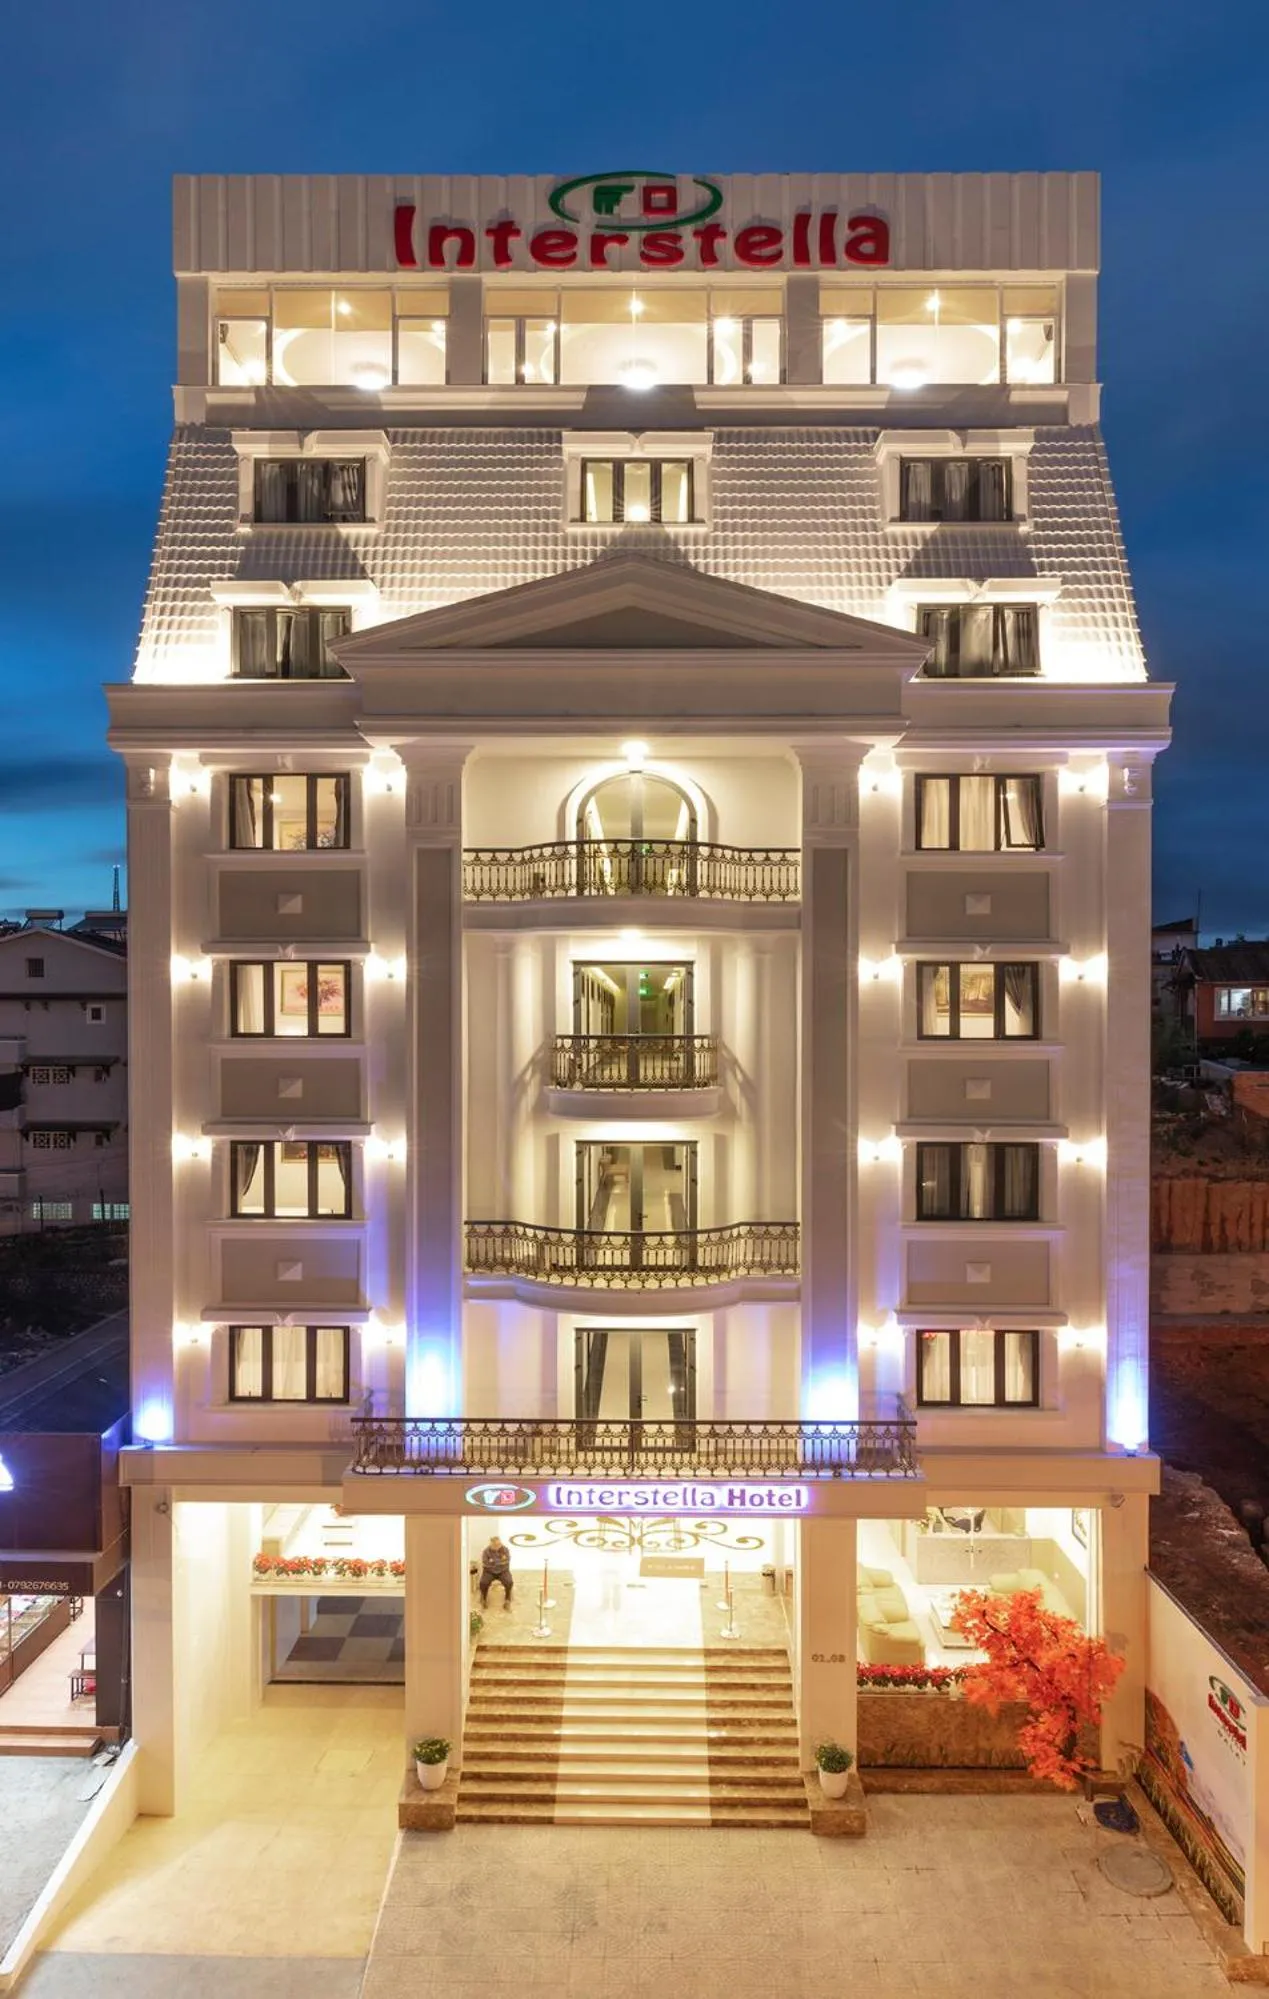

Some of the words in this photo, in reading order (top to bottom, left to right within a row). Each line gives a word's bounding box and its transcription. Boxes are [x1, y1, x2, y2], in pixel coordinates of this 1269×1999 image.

[393, 204, 890, 268] Interstella
[555, 1486, 716, 1507] Interstella
[727, 1487, 802, 1508] Hotel
